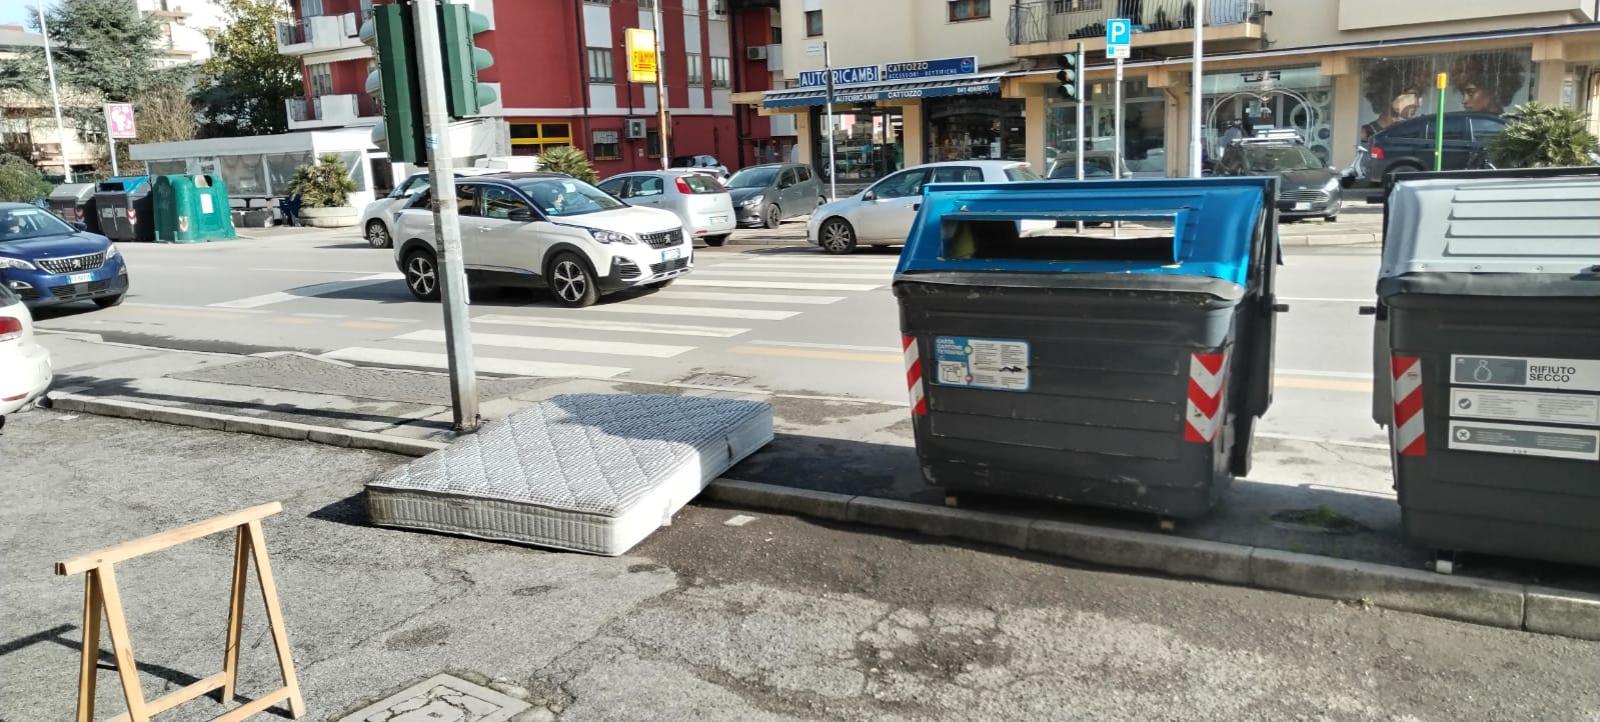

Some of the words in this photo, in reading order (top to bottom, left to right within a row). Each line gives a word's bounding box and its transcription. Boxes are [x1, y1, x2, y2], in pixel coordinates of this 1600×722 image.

[1111, 21, 1126, 43] P
[888, 62, 928, 73] CATTOZZO
[801, 66, 878, 86] AUTORICAMBI
[835, 92, 879, 103] AUTORICAMBI
[887, 90, 922, 98] CATTOZZO
[1529, 365, 1576, 375] RIFIUTO
[1529, 373, 1570, 382] SECCO
